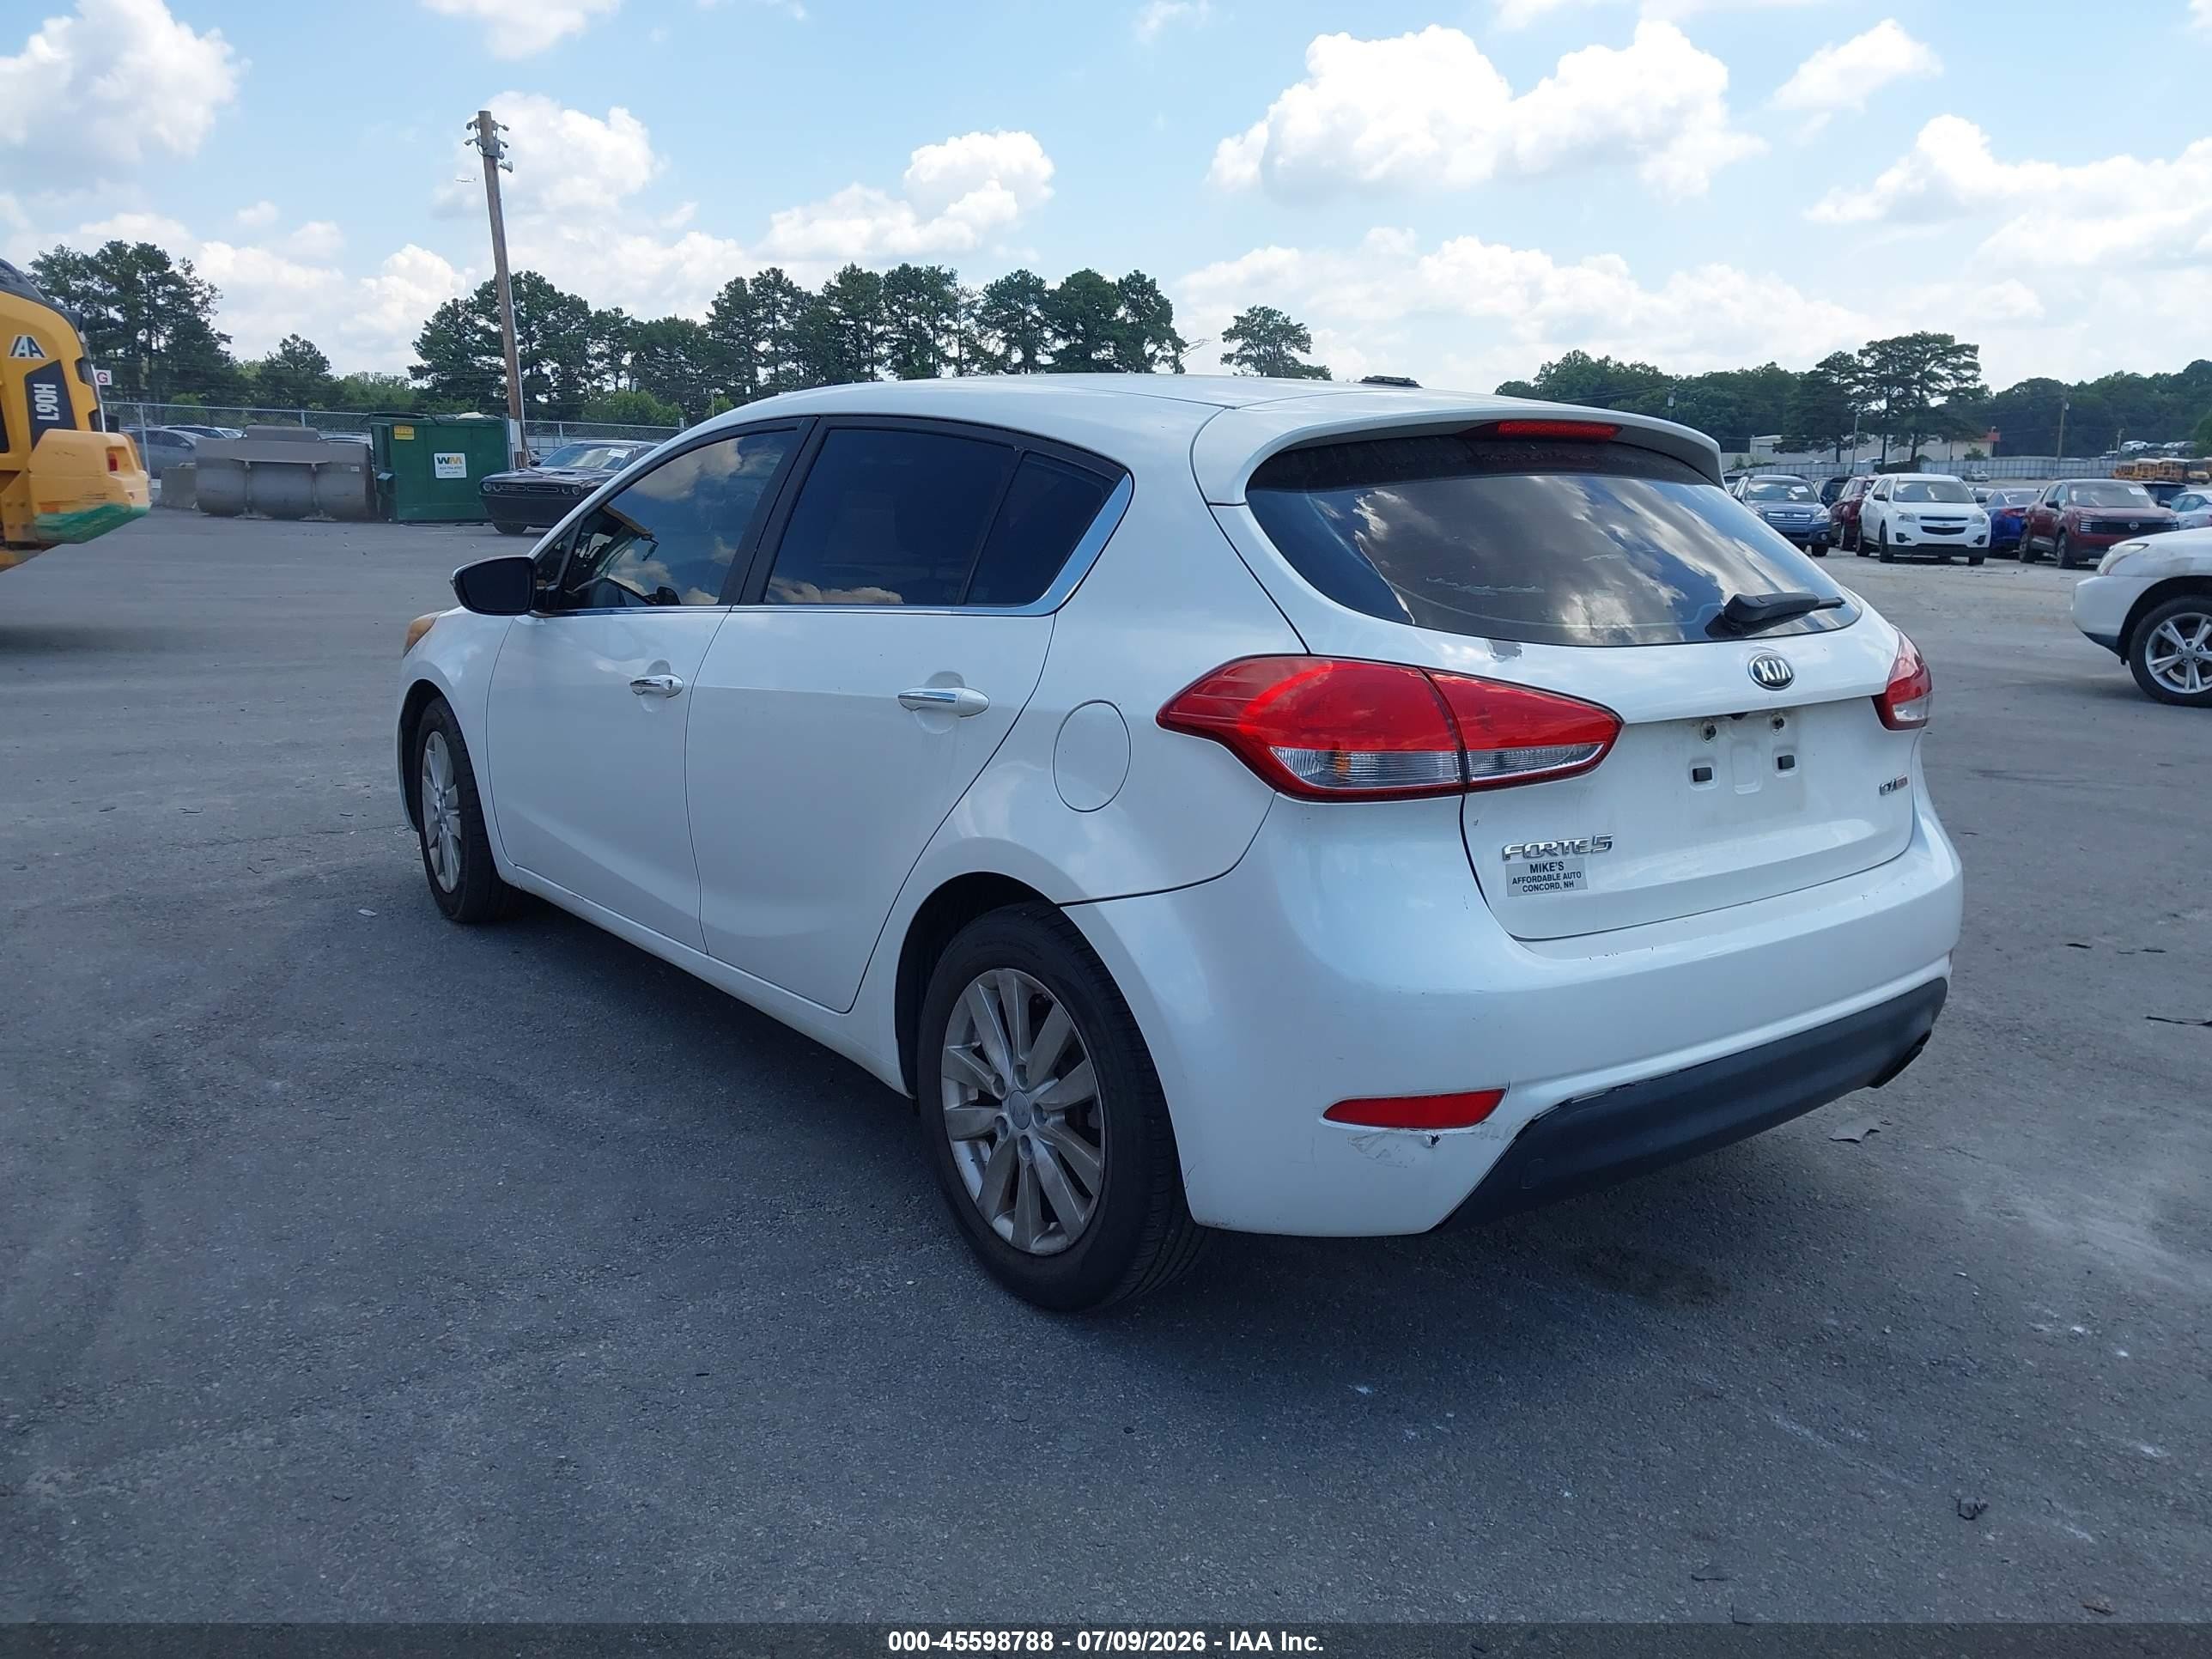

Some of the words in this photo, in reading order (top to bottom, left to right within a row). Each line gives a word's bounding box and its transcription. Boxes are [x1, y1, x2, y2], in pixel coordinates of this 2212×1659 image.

[33, 383, 60, 421] L90H
[1756, 659, 1792, 682] KIA
[1529, 861, 1565, 874] MIKE'S
[1511, 872, 1561, 885] AFFORDABLE
[1563, 871, 1582, 881] AUTO
[1522, 883, 1562, 893] CONCORD,
[1564, 880, 1575, 889] NH
